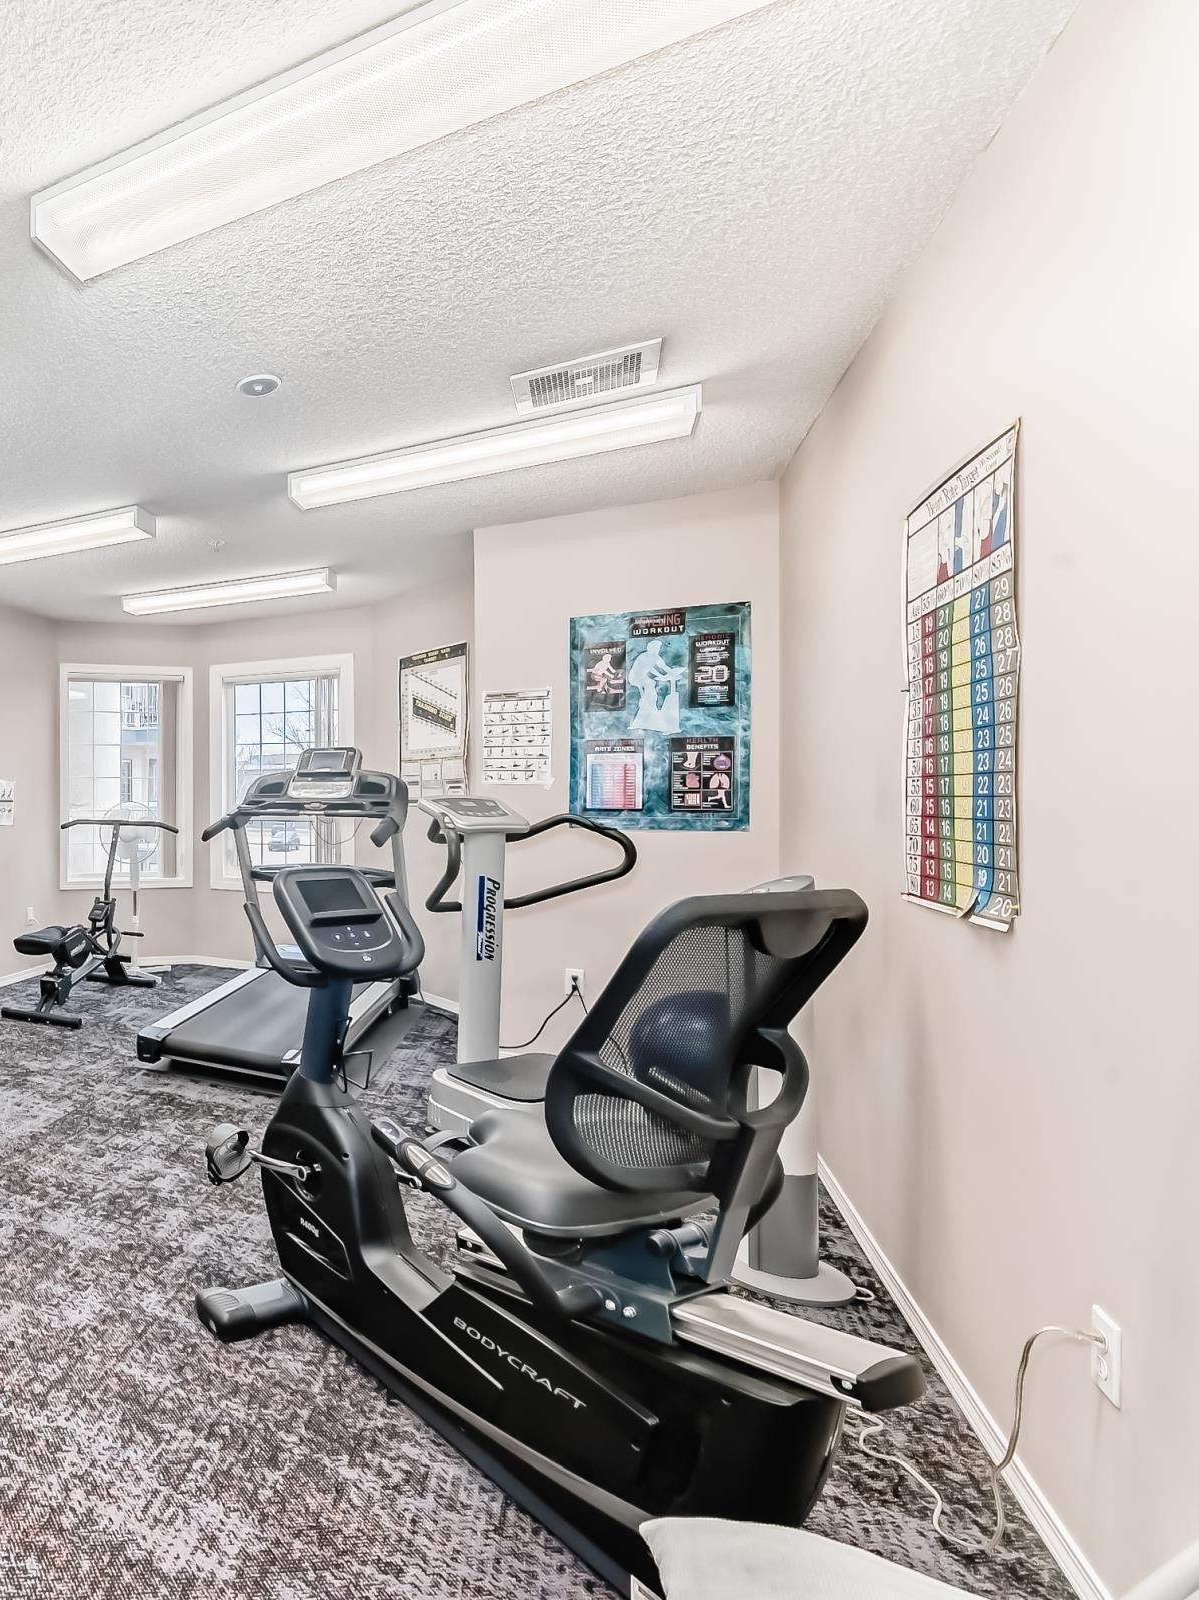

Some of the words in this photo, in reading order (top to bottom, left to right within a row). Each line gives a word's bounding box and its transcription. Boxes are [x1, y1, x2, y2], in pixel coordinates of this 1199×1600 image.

[925, 616, 933, 633] 19
[939, 607, 949, 626] 21
[975, 587, 985, 610] 27
[994, 578, 1009, 600] 29
[633, 625, 684, 635] WORKOUT
[695, 639, 731, 647] WORKOUT
[925, 637, 932, 653] 18
[939, 630, 948, 647] 20
[974, 612, 985, 633] 27
[995, 602, 1011, 624] 28
[925, 657, 933, 674] 18
[940, 651, 947, 668] 19
[975, 636, 986, 656] 26
[997, 627, 1012, 648] 28
[695, 664, 730, 684] 20
[925, 677, 933, 694] 17
[940, 672, 947, 689] 19
[976, 659, 987, 679] 25
[998, 649, 1012, 672] 27
[925, 698, 933, 714] 17
[940, 694, 947, 710] 19
[976, 683, 988, 702] 25
[999, 676, 1012, 697] 26
[925, 718, 933, 734] 17
[940, 715, 948, 732] 18
[977, 706, 989, 725] 24
[999, 701, 1011, 721] 26
[925, 738, 933, 757] 16
[940, 735, 949, 751] 18
[978, 729, 989, 748] 23
[999, 726, 1012, 745] 25
[925, 759, 933, 774] 16
[941, 757, 948, 773] 17
[978, 753, 989, 771] 23
[999, 750, 1011, 769] 24
[925, 779, 934, 794] 15
[941, 778, 949, 794] 17
[978, 776, 988, 794] 22
[998, 775, 1011, 793] 23
[926, 799, 934, 815] 15
[941, 800, 950, 816] 16
[977, 799, 987, 816] 21
[999, 800, 1011, 818] 23
[926, 819, 934, 835] 14
[942, 821, 950, 836] 16
[977, 823, 987, 840] 21
[999, 824, 1011, 842] 22
[909, 837, 918, 852] 70
[926, 840, 935, 856] 14
[942, 842, 951, 858] 15
[977, 846, 989, 864] 20
[999, 848, 1010, 867] 21
[926, 860, 935, 876] 13
[943, 863, 951, 879] 15
[978, 869, 987, 887] 19
[999, 873, 1010, 892] 21
[926, 880, 934, 896] 13
[943, 884, 951, 900] 14
[989, 897, 1012, 917] 20
[453, 1317, 586, 1408] BODYCRAFT
